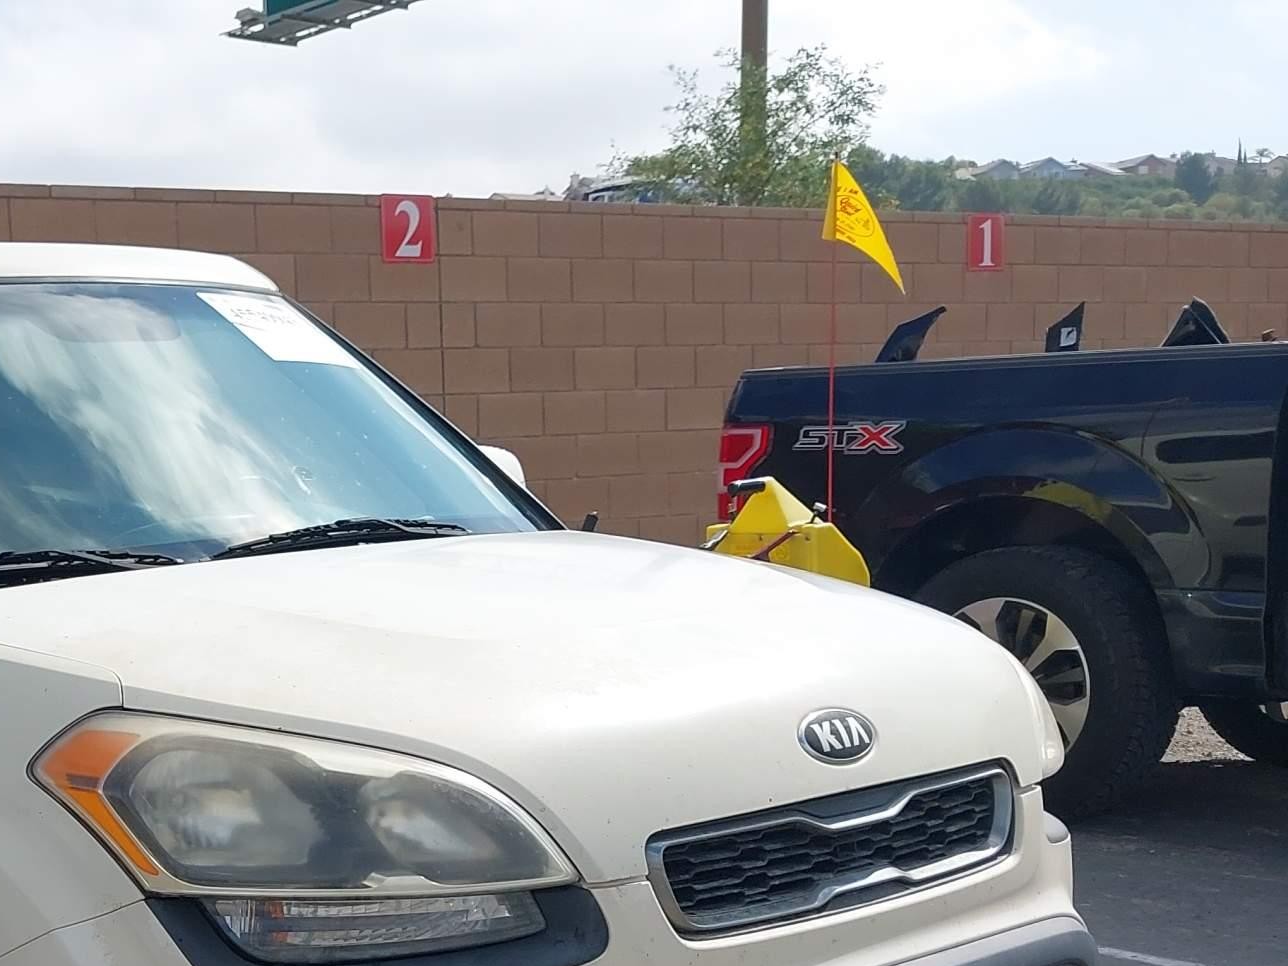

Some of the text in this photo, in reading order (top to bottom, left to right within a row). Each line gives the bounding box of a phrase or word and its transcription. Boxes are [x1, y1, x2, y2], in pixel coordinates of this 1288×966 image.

[394, 200, 423, 257] 2
[978, 218, 995, 266] 1
[792, 421, 906, 455] STX
[809, 716, 871, 753] KIA
